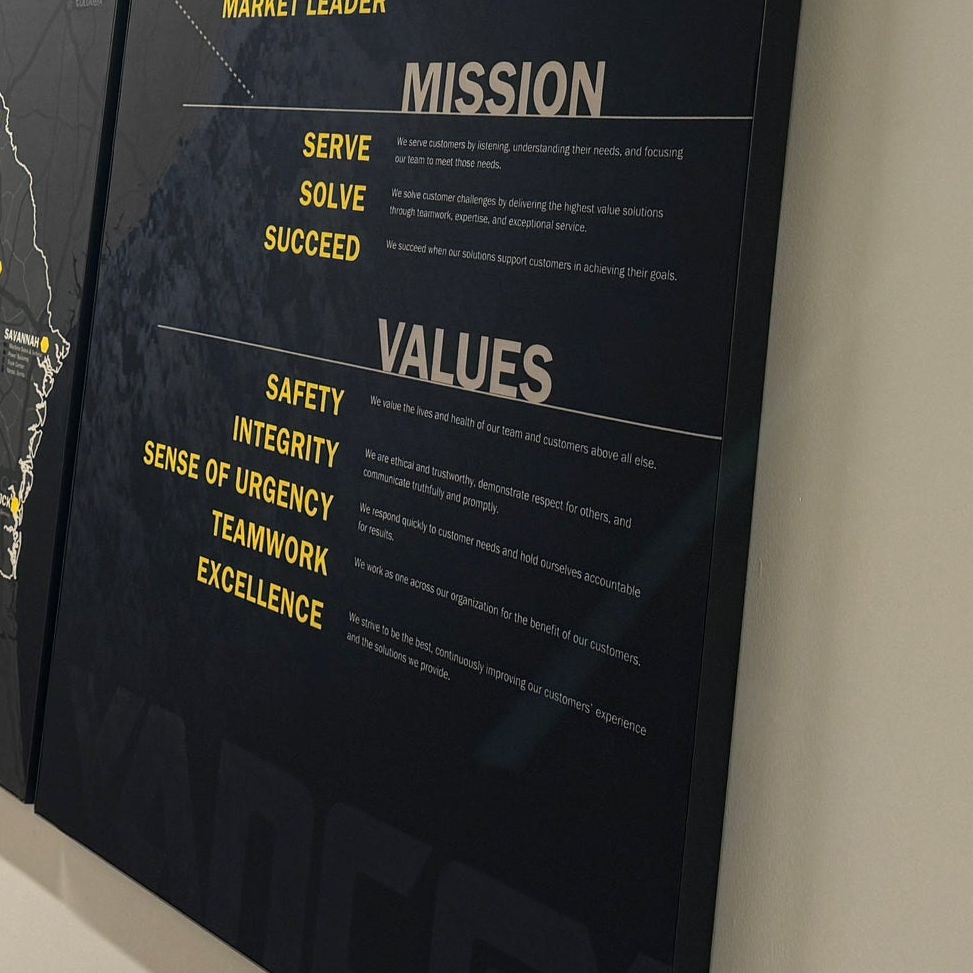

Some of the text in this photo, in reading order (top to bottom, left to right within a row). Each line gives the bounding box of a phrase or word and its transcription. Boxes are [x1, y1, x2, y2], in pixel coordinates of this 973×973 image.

[400, 61, 606, 116] MISSION
[302, 131, 372, 161] SERVE
[396, 136, 683, 160] We serve customers by listening, understanding their needs, and focusing
[299, 180, 367, 212] SOLVE
[391, 187, 663, 218] We solve customer challenges by delivering the highest value solutions
[263, 224, 361, 262] SUCCEED
[4, 328, 40, 349] SAVANNAH
[378, 318, 554, 403] VALUES
[265, 373, 345, 416] SAFETY
[232, 415, 340, 469] INTEGRITY
[370, 394, 656, 469] We value the lives and health of our team and customers above all else.
[143, 440, 336, 522] SENSE OF URGENCY
[362, 468, 499, 515] communicate truthfully and promptly.
[212, 509, 329, 577] TEAMWORK
[357, 520, 394, 541] for results.
[196, 555, 324, 631] EXCELLENCE
[354, 556, 640, 666] We work as one across our organization for the benefit of our customers.
